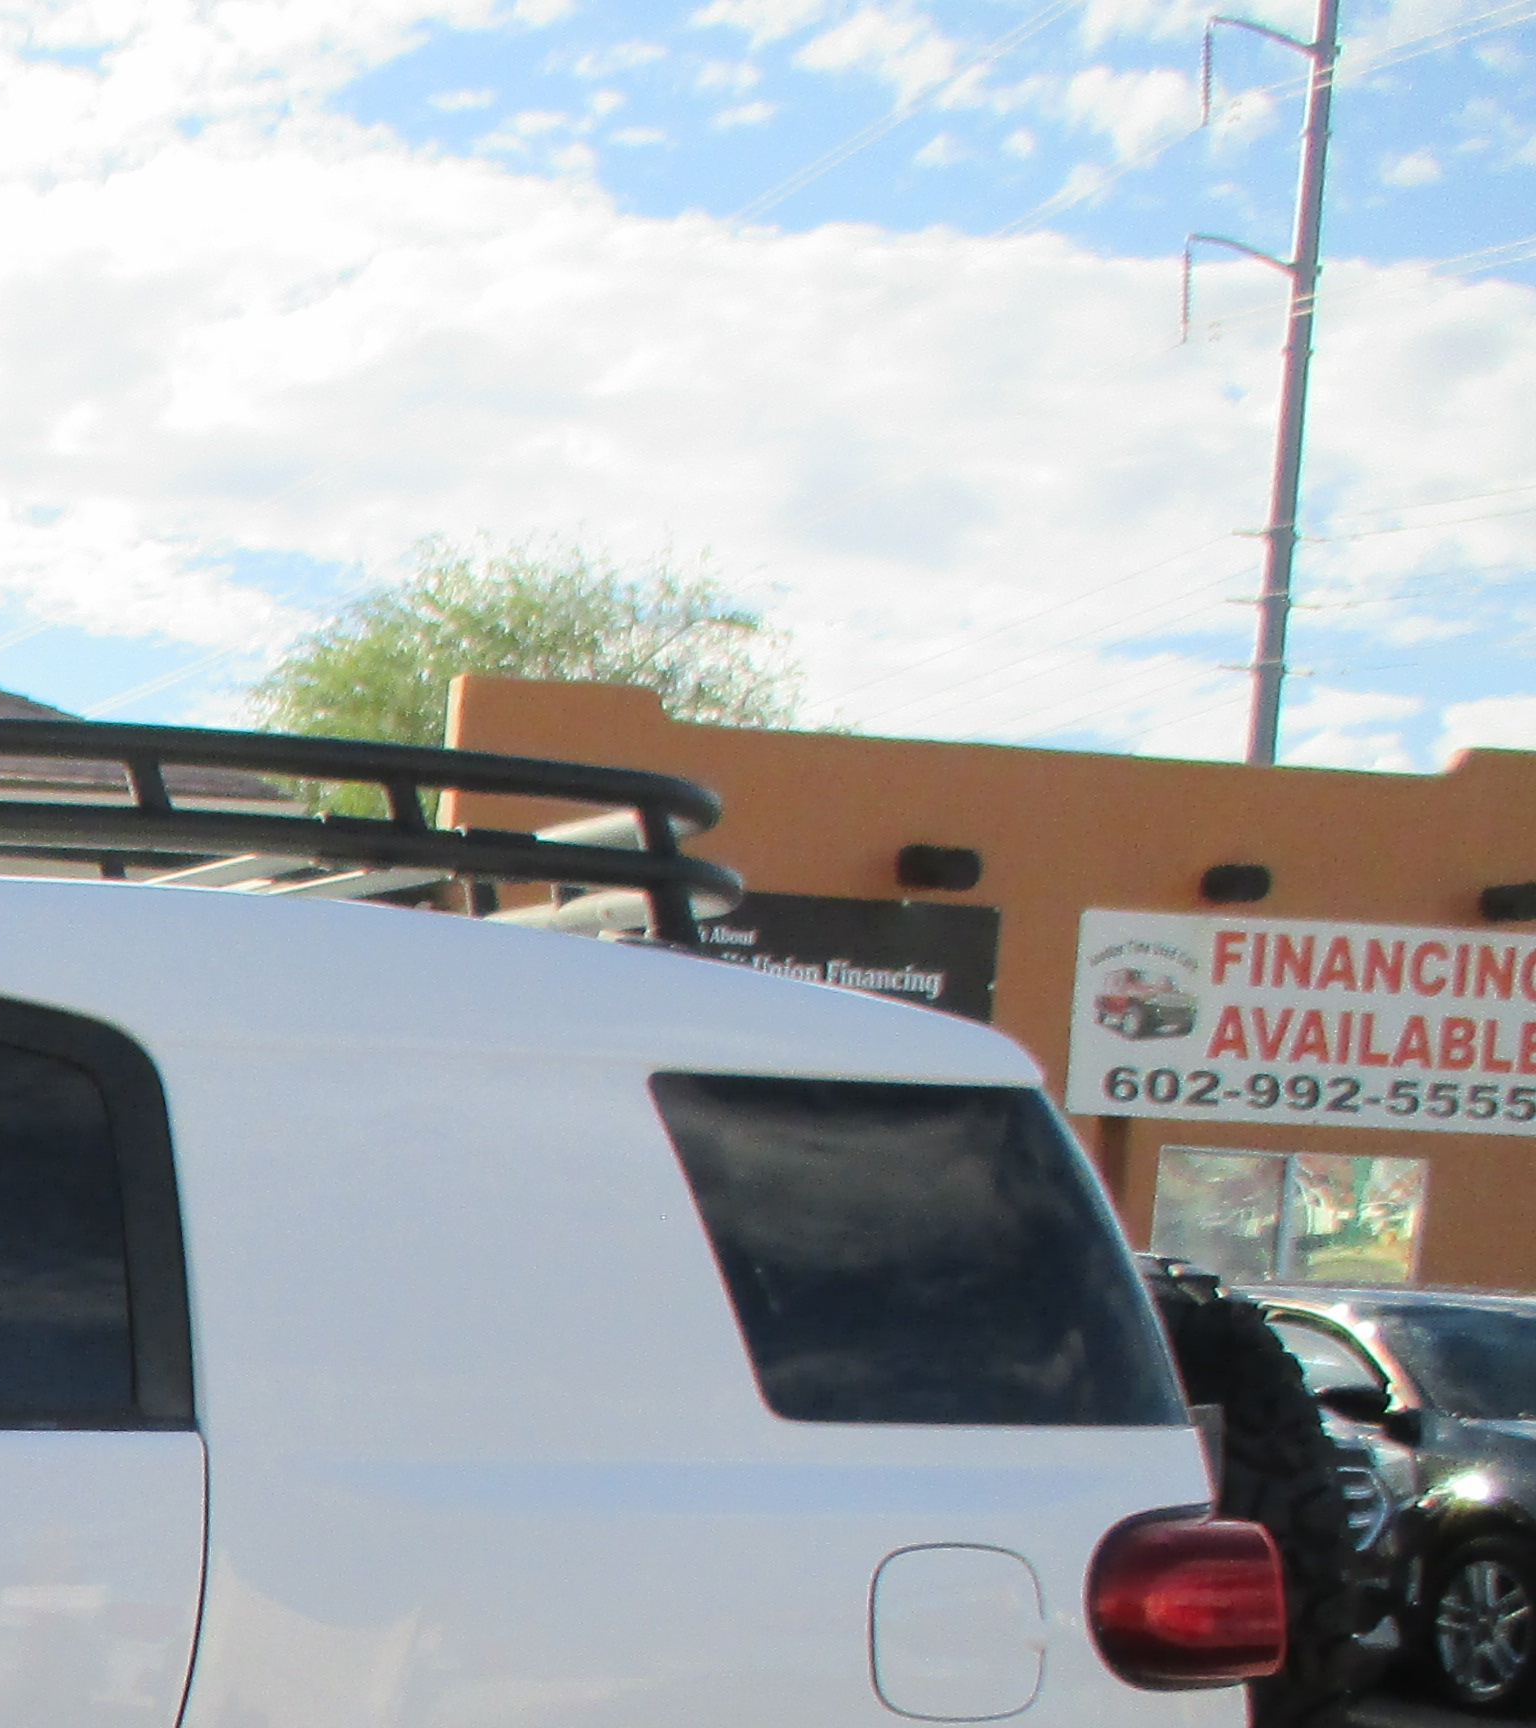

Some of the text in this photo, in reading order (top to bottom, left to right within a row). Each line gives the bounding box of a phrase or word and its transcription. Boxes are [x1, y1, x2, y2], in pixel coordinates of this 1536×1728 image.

[709, 925, 756, 946] About
[826, 957, 945, 1001] Financing
[1205, 1004, 1536, 1074] AVAILABLE
[1102, 1065, 1536, 1121] 602-992-5555
